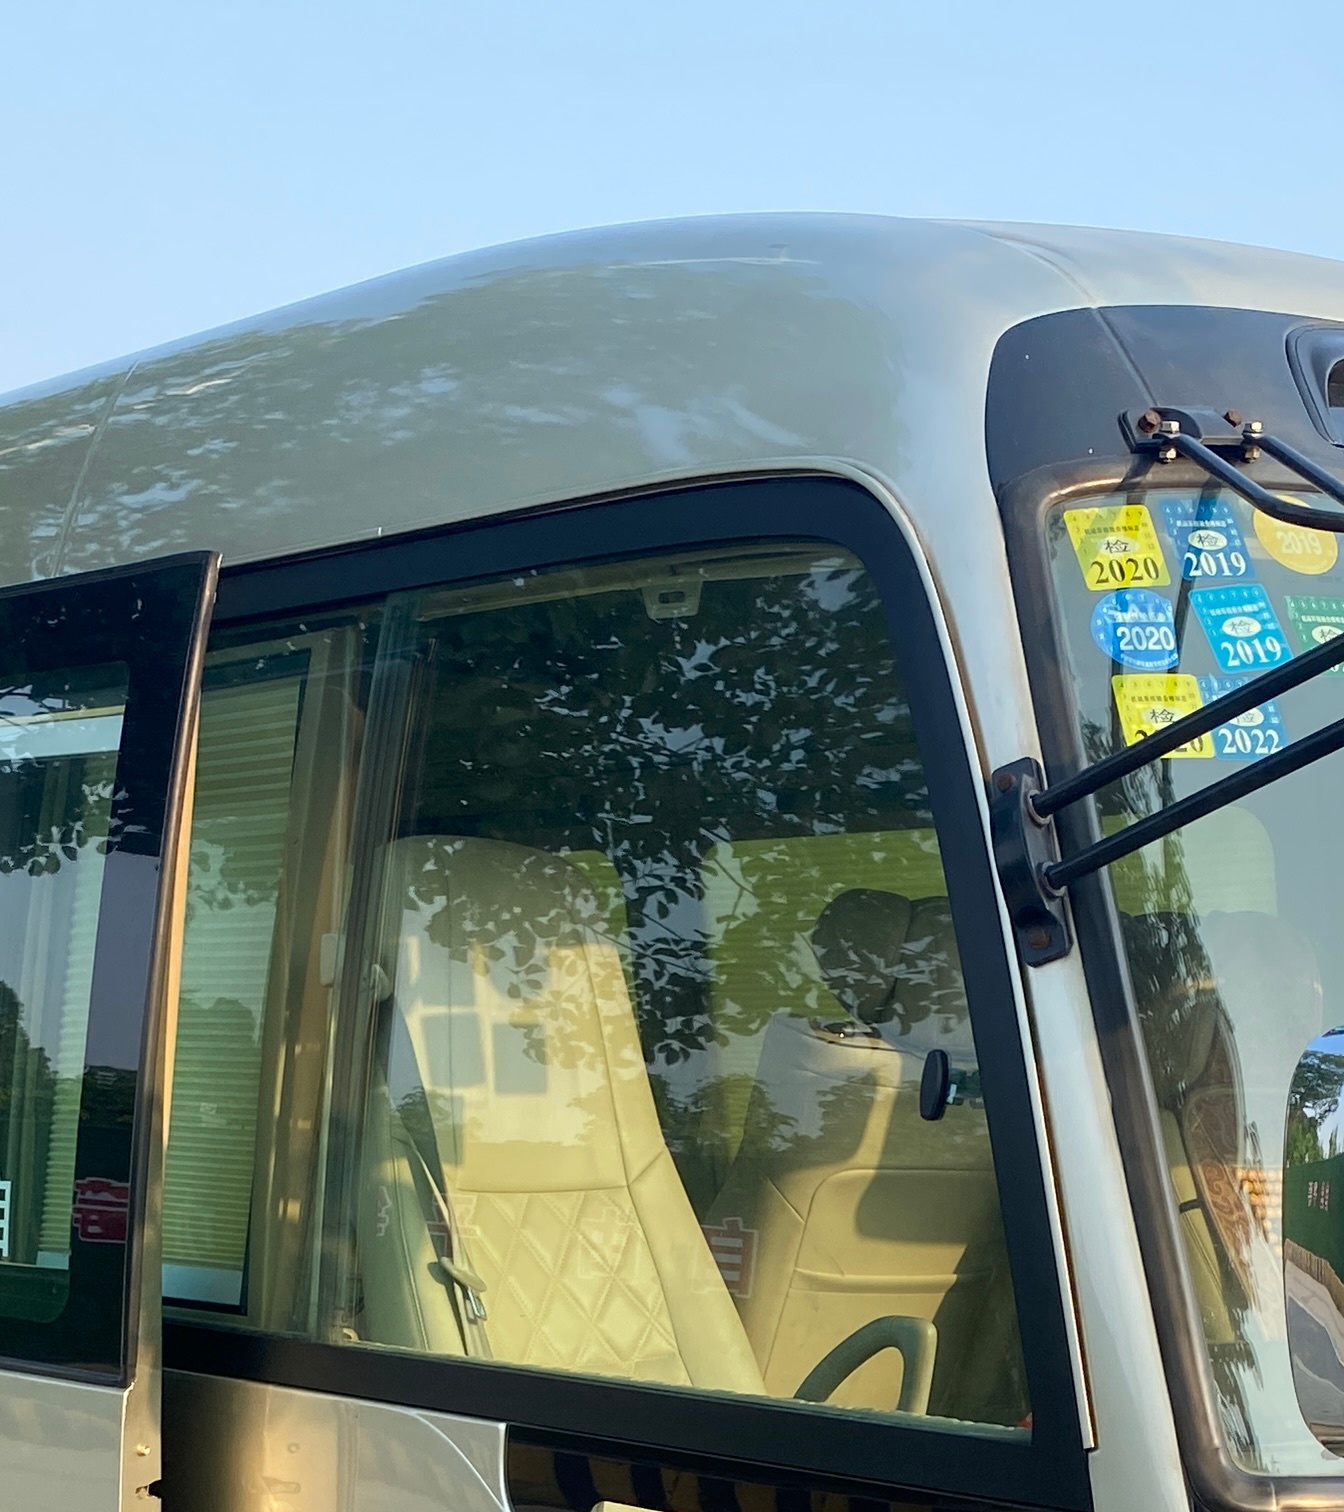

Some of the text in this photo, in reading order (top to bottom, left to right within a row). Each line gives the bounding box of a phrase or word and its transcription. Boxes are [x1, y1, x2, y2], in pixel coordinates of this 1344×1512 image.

[1104, 539, 1131, 554] 检
[1276, 530, 1323, 555] 2019
[1090, 557, 1159, 585] 2020
[1184, 551, 1246, 577] 2019
[1116, 625, 1175, 651] 2020
[1220, 636, 1282, 667] 2019
[1218, 728, 1284, 754] 2022
